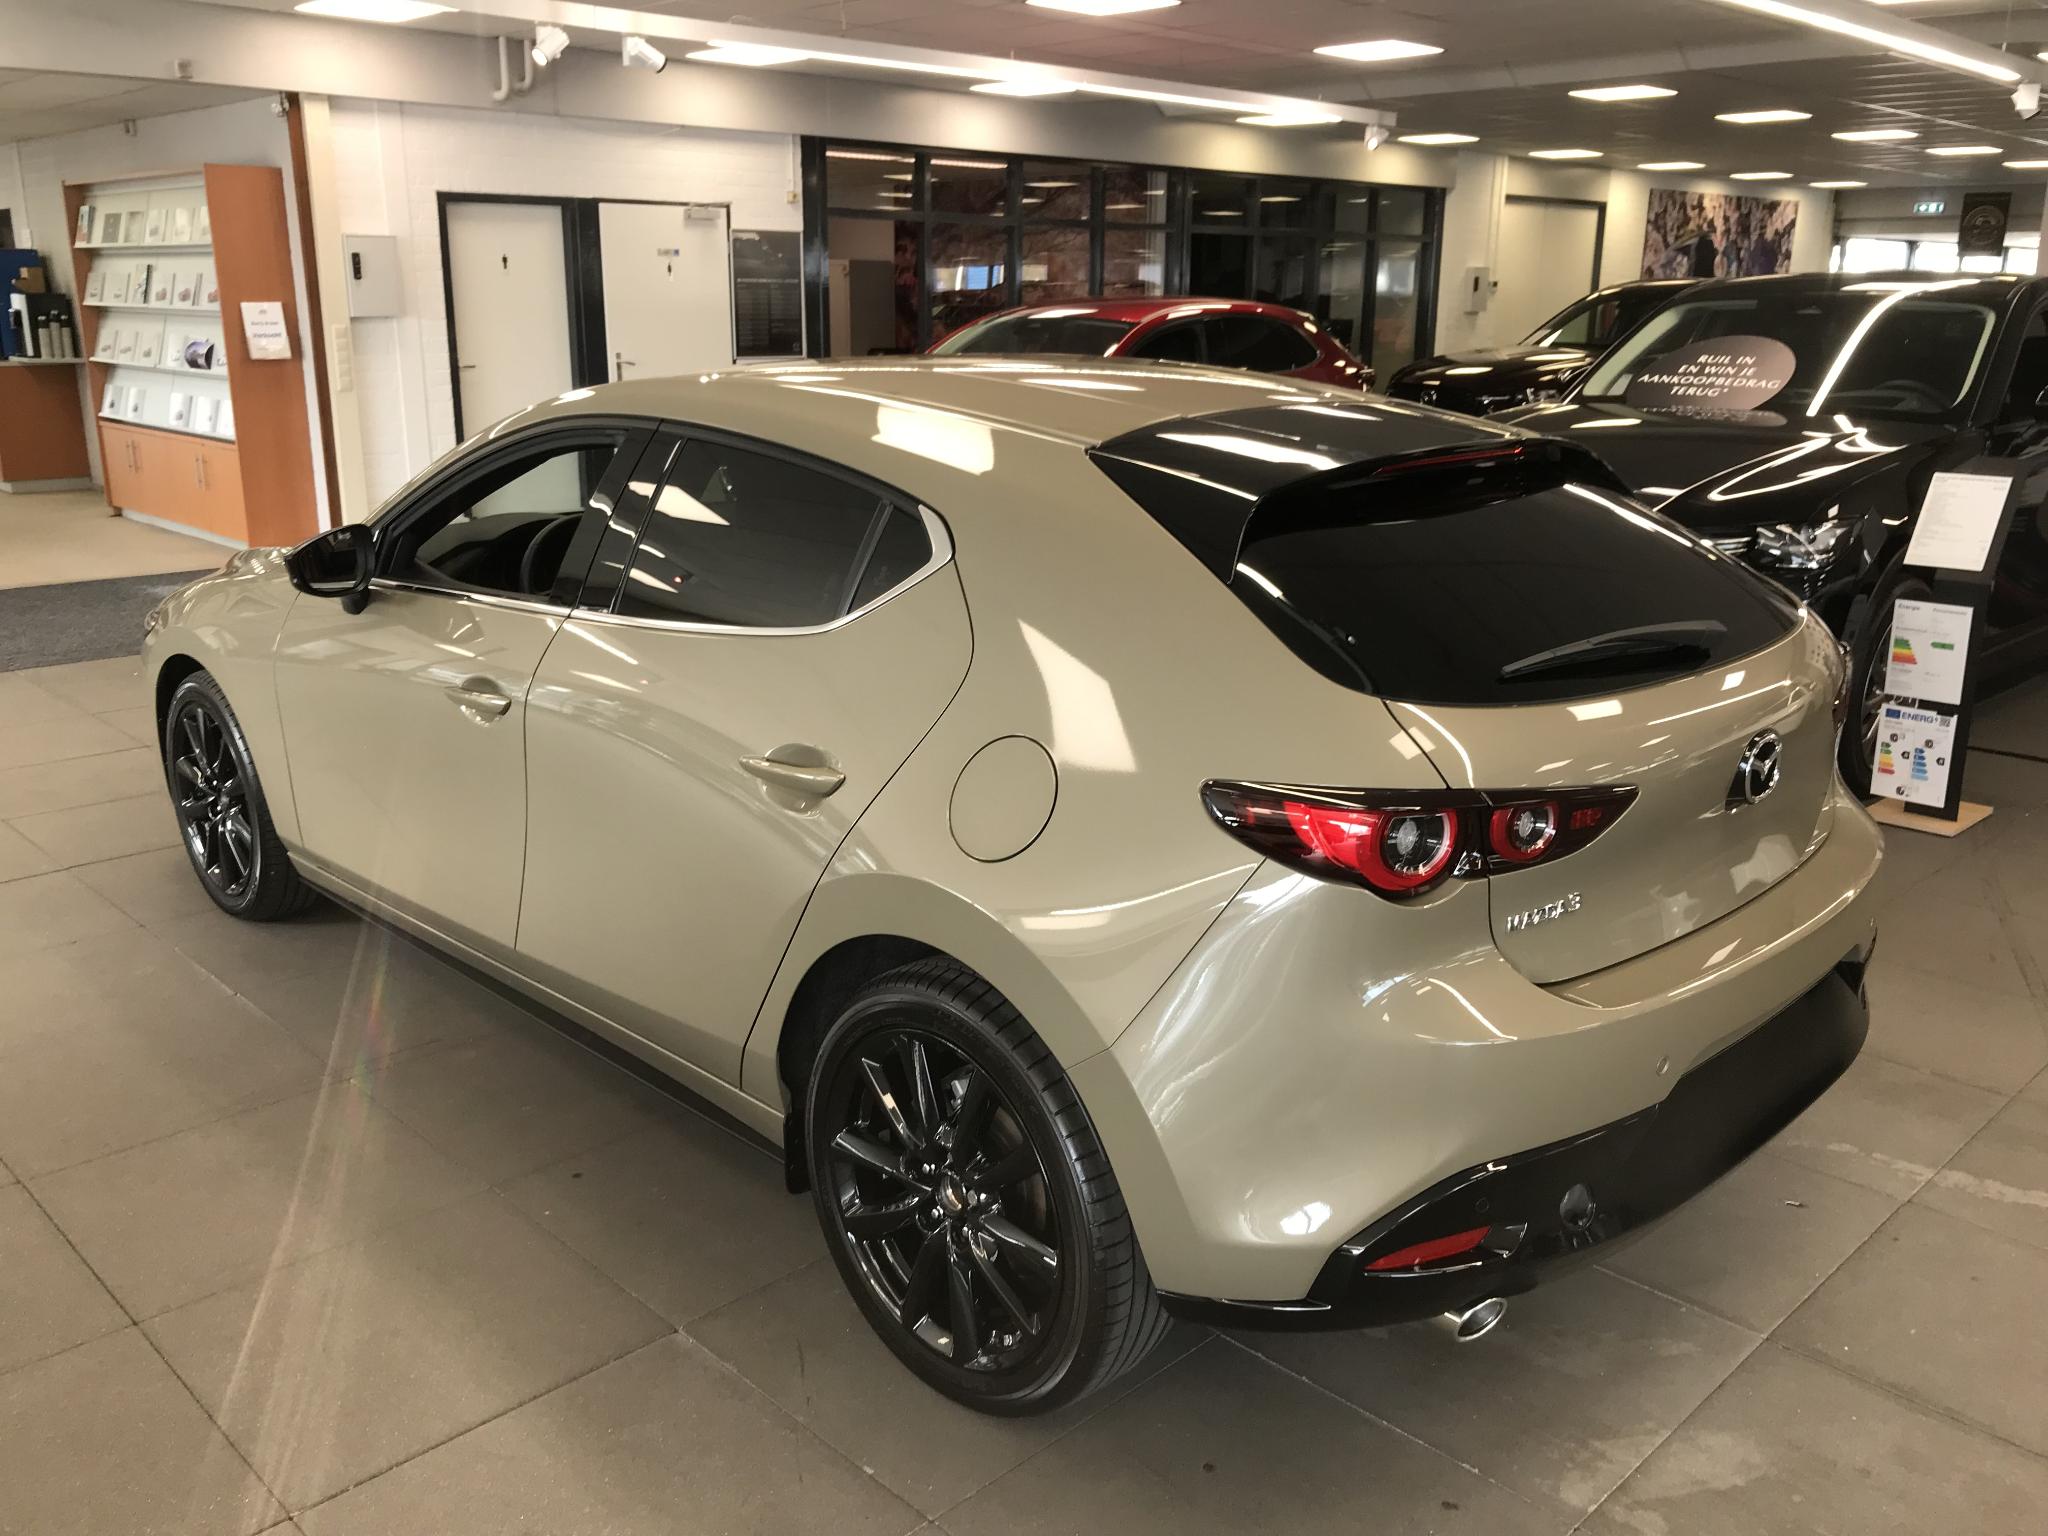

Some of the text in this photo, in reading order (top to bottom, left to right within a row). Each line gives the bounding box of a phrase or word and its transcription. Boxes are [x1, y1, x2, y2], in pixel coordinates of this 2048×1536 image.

[1697, 354, 1756, 365] RUIL IN
[1678, 365, 1755, 376] EN WIN JE
[1637, 374, 1781, 389] AANKOOPBEDRAG
